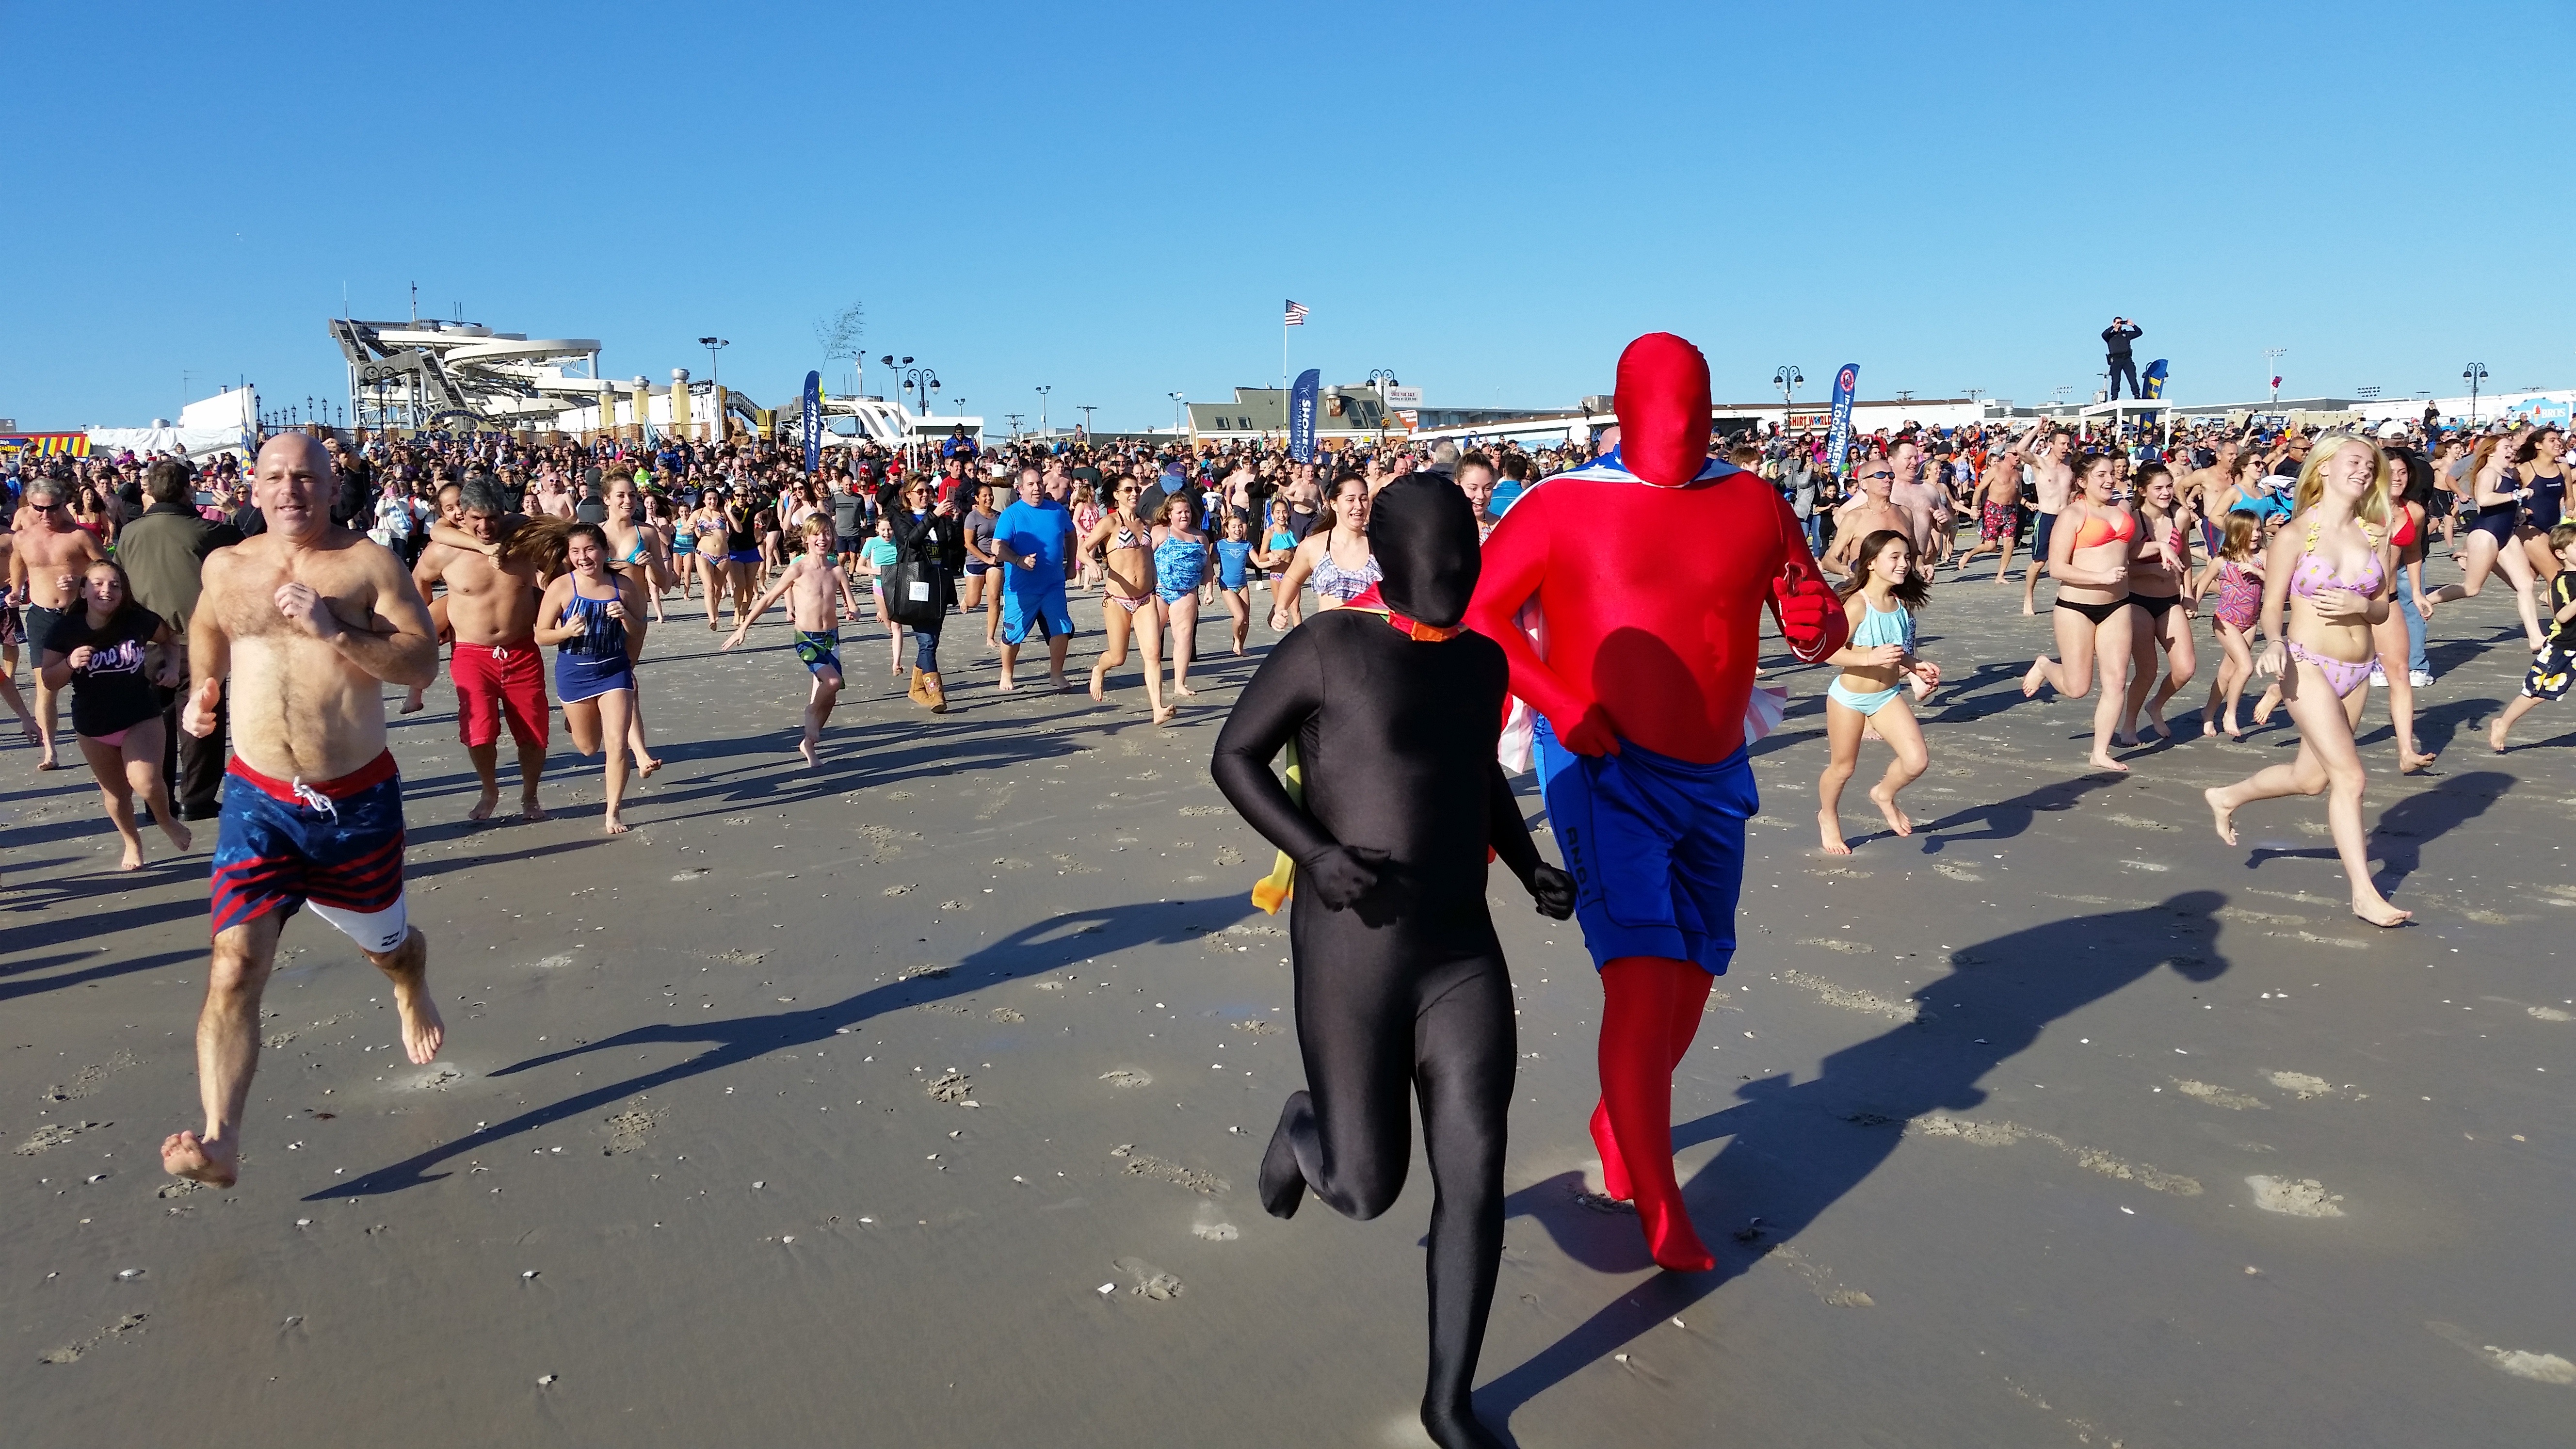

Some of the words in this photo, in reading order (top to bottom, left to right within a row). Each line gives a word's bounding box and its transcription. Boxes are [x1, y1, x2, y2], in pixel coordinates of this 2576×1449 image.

[1789, 416, 1807, 427] SHIRT
[1830, 403, 1844, 437] LOCAL
[2542, 408, 2566, 419] BROS
[1831, 422, 1847, 473] WORKERS
[78, 647, 117, 671] ero
